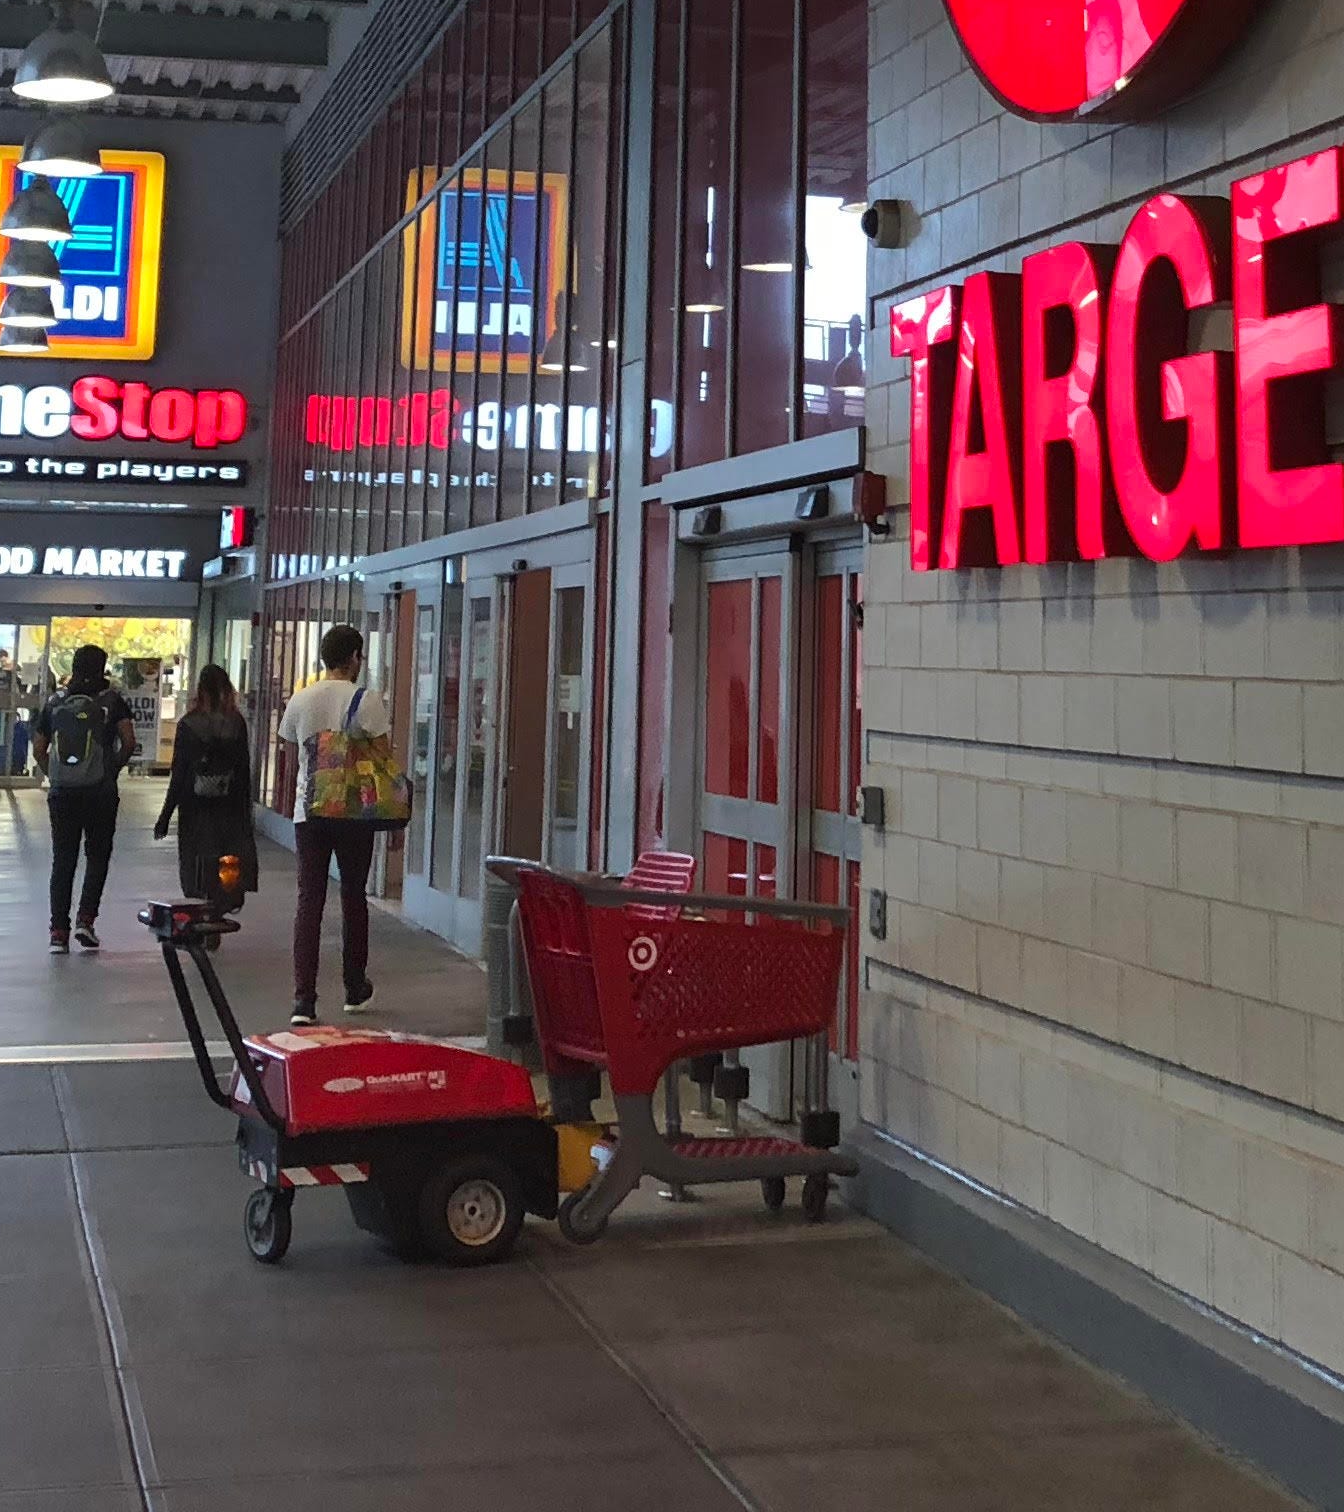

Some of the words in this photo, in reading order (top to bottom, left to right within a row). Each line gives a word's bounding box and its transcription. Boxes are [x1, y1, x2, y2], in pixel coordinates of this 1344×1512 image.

[49, 282, 119, 322] LDI
[25, 457, 86, 475] the
[97, 460, 239, 480] players
[43, 547, 186, 578] MARKET
[132, 710, 156, 722] OW
